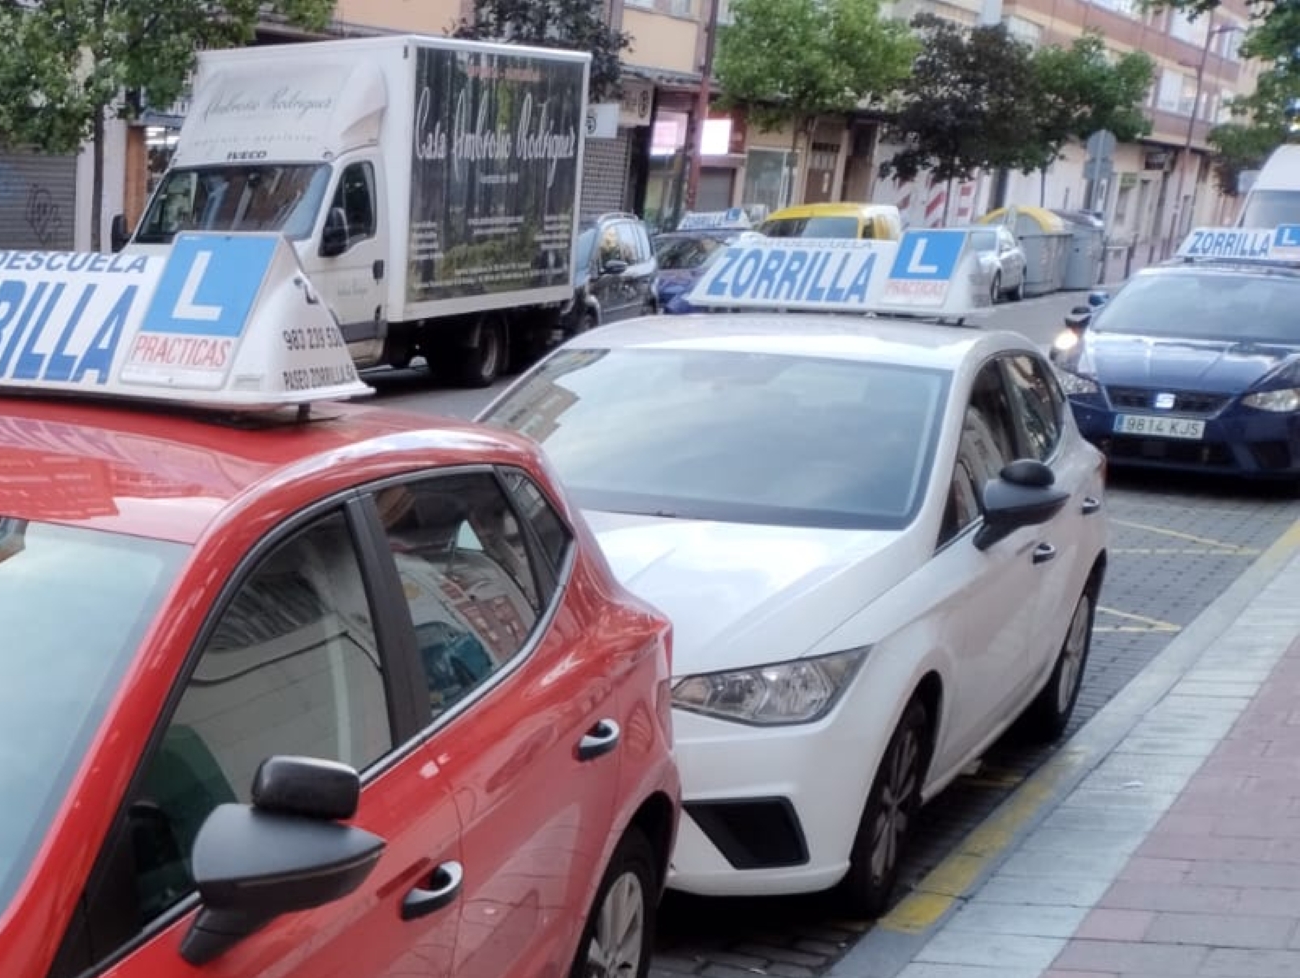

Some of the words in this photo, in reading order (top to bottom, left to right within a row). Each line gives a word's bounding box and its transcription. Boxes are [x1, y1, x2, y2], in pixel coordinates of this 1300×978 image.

[1188, 231, 1271, 257] ZORRILLA
[1281, 228, 1298, 244] L
[907, 238, 938, 274] L
[171, 250, 222, 321] L
[706, 249, 878, 304] ZORRILLA
[131, 332, 231, 368] PRACTICAS
[1127, 418, 1164, 432] 9814
[1169, 421, 1200, 436] KJS
